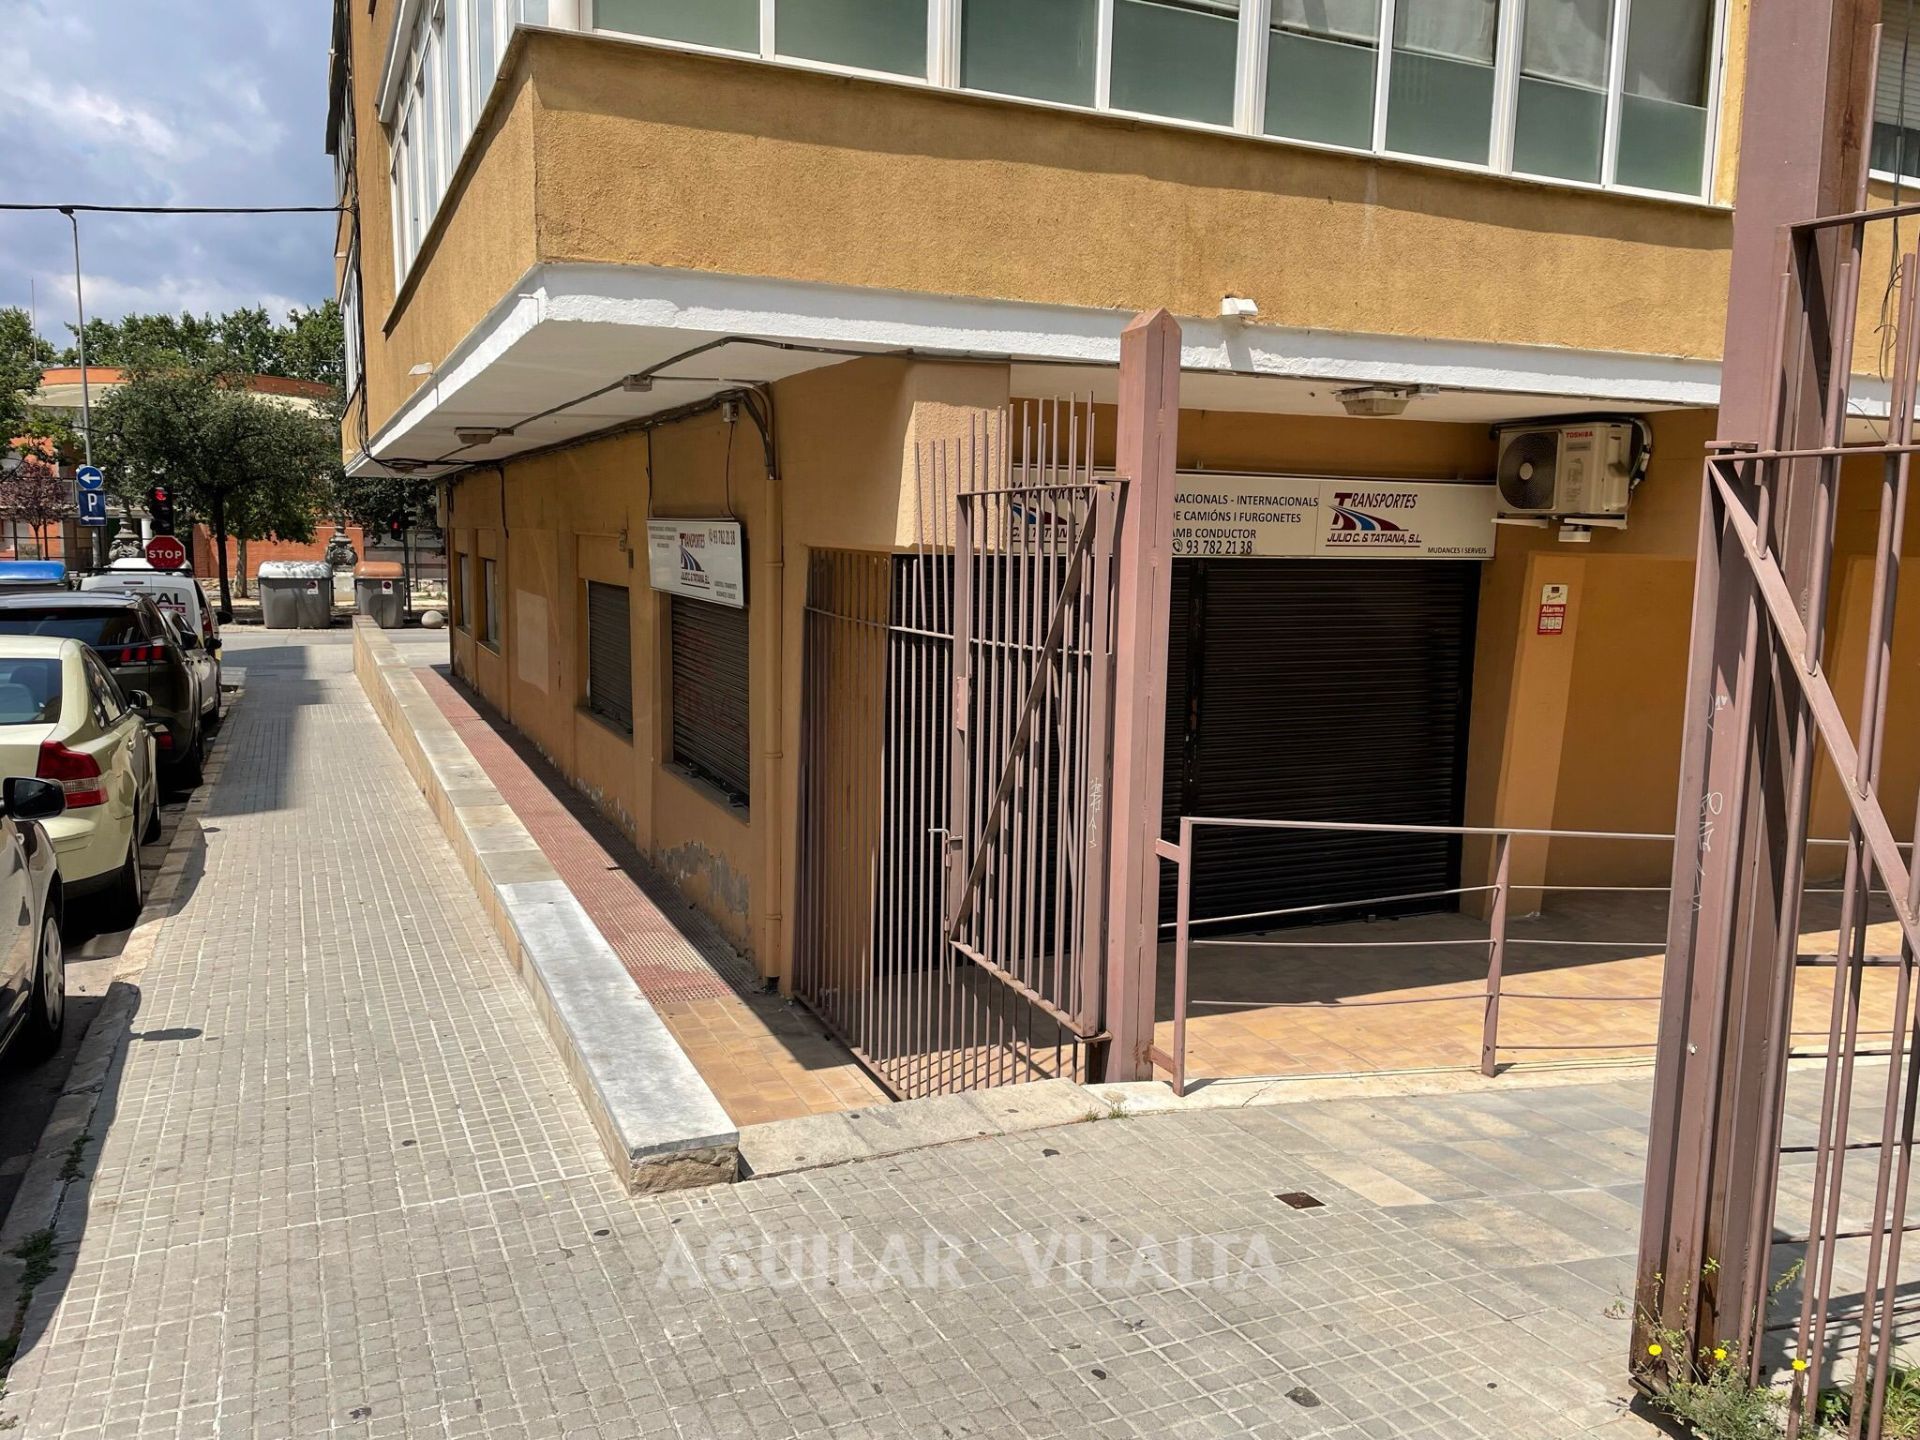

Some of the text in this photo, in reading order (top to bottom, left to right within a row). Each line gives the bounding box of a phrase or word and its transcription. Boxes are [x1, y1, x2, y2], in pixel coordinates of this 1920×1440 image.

[87, 493, 97, 512] P
[1237, 495, 1319, 507] INTERNACIONALS
[1333, 492, 1418, 509] TRANSPORTES
[1184, 508, 1231, 522] CAMIÓNS
[1233, 512, 1237, 522] I
[1239, 512, 1301, 523] FURGONETES
[1195, 528, 1257, 539] CONDUCTOR
[1327, 533, 1352, 543] JULIO
[1362, 533, 1368, 543] &
[1370, 533, 1407, 544] TATIANA,
[1186, 540, 1252, 555] 93 782 21 38
[1428, 546, 1460, 554] MUDANCES
[149, 550, 182, 559] STOP
